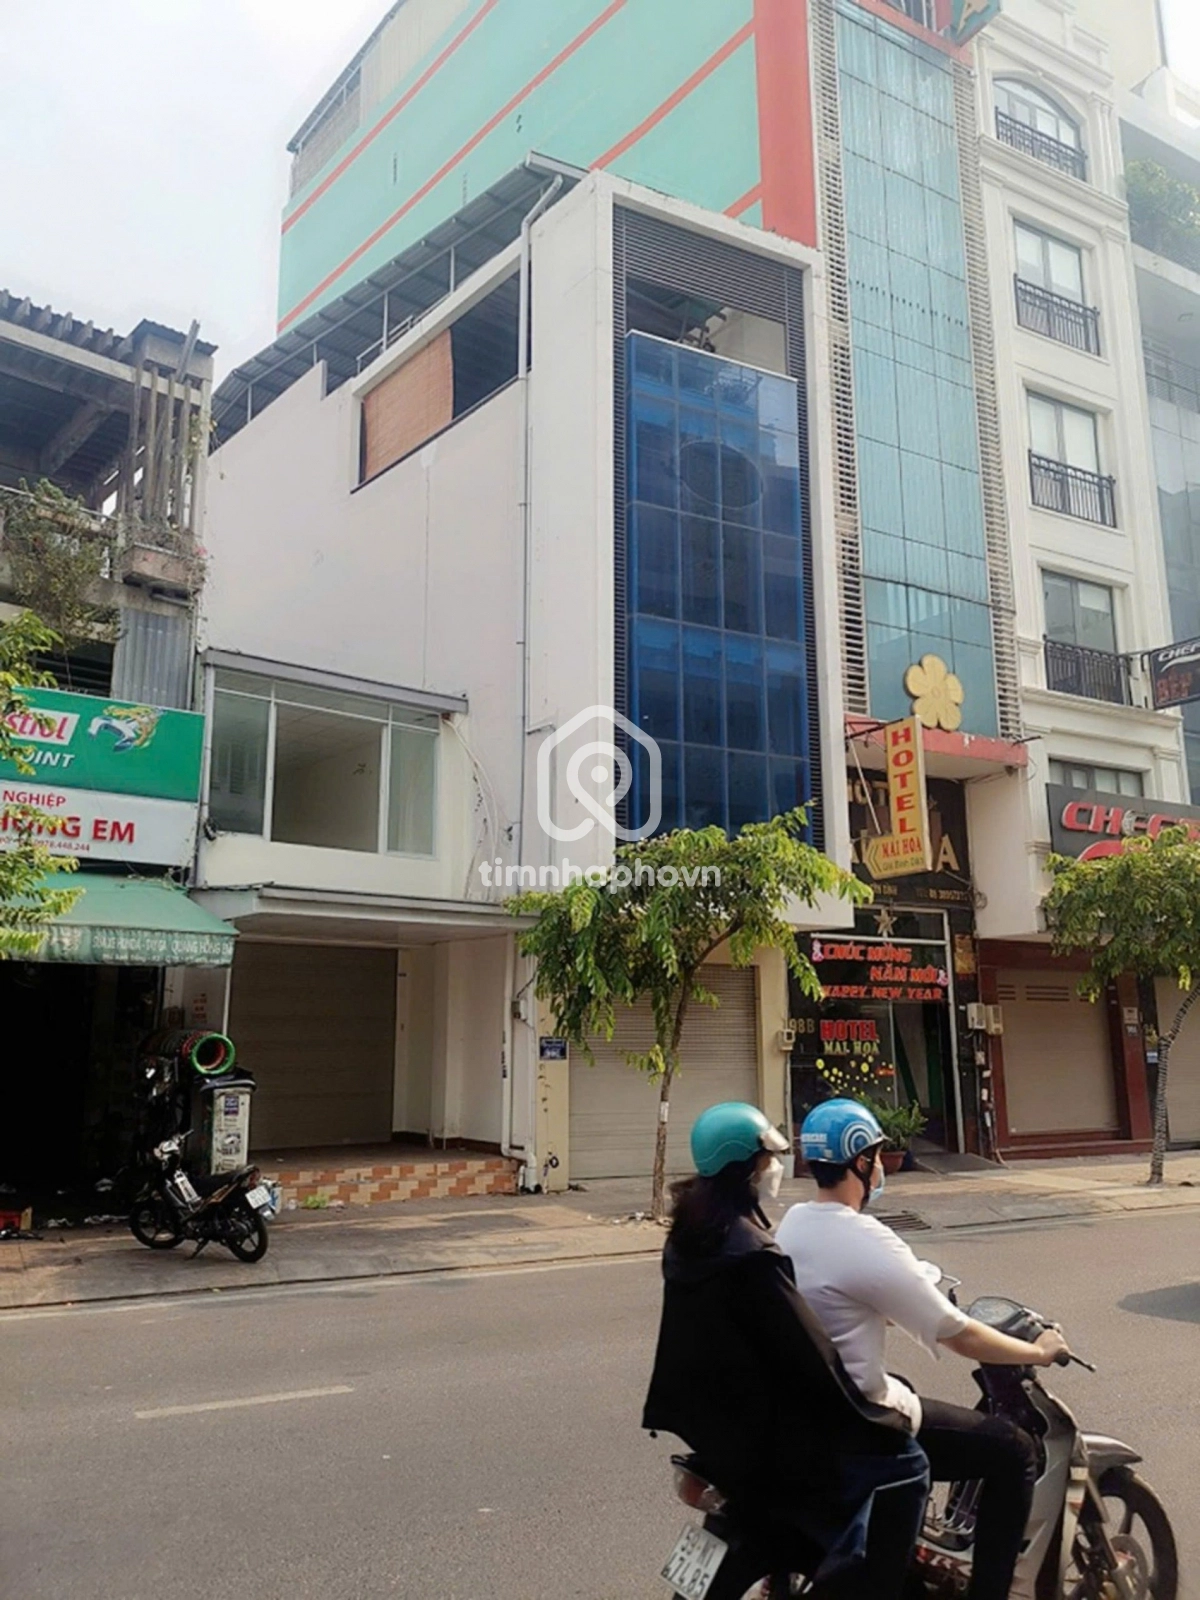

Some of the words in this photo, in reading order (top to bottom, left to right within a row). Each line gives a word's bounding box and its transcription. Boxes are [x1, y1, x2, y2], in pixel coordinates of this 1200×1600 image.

[890, 727, 917, 834] HOTEL
[3, 790, 66, 808] NGHIỆP
[92, 818, 135, 843] EM
[823, 940, 864, 960] CHÚC
[867, 942, 912, 963] MỪNG
[870, 963, 907, 982] NĂM
[872, 986, 901, 1000] NEW
[906, 988, 943, 1000] YEAR
[820, 1019, 878, 1041] HOTEL
